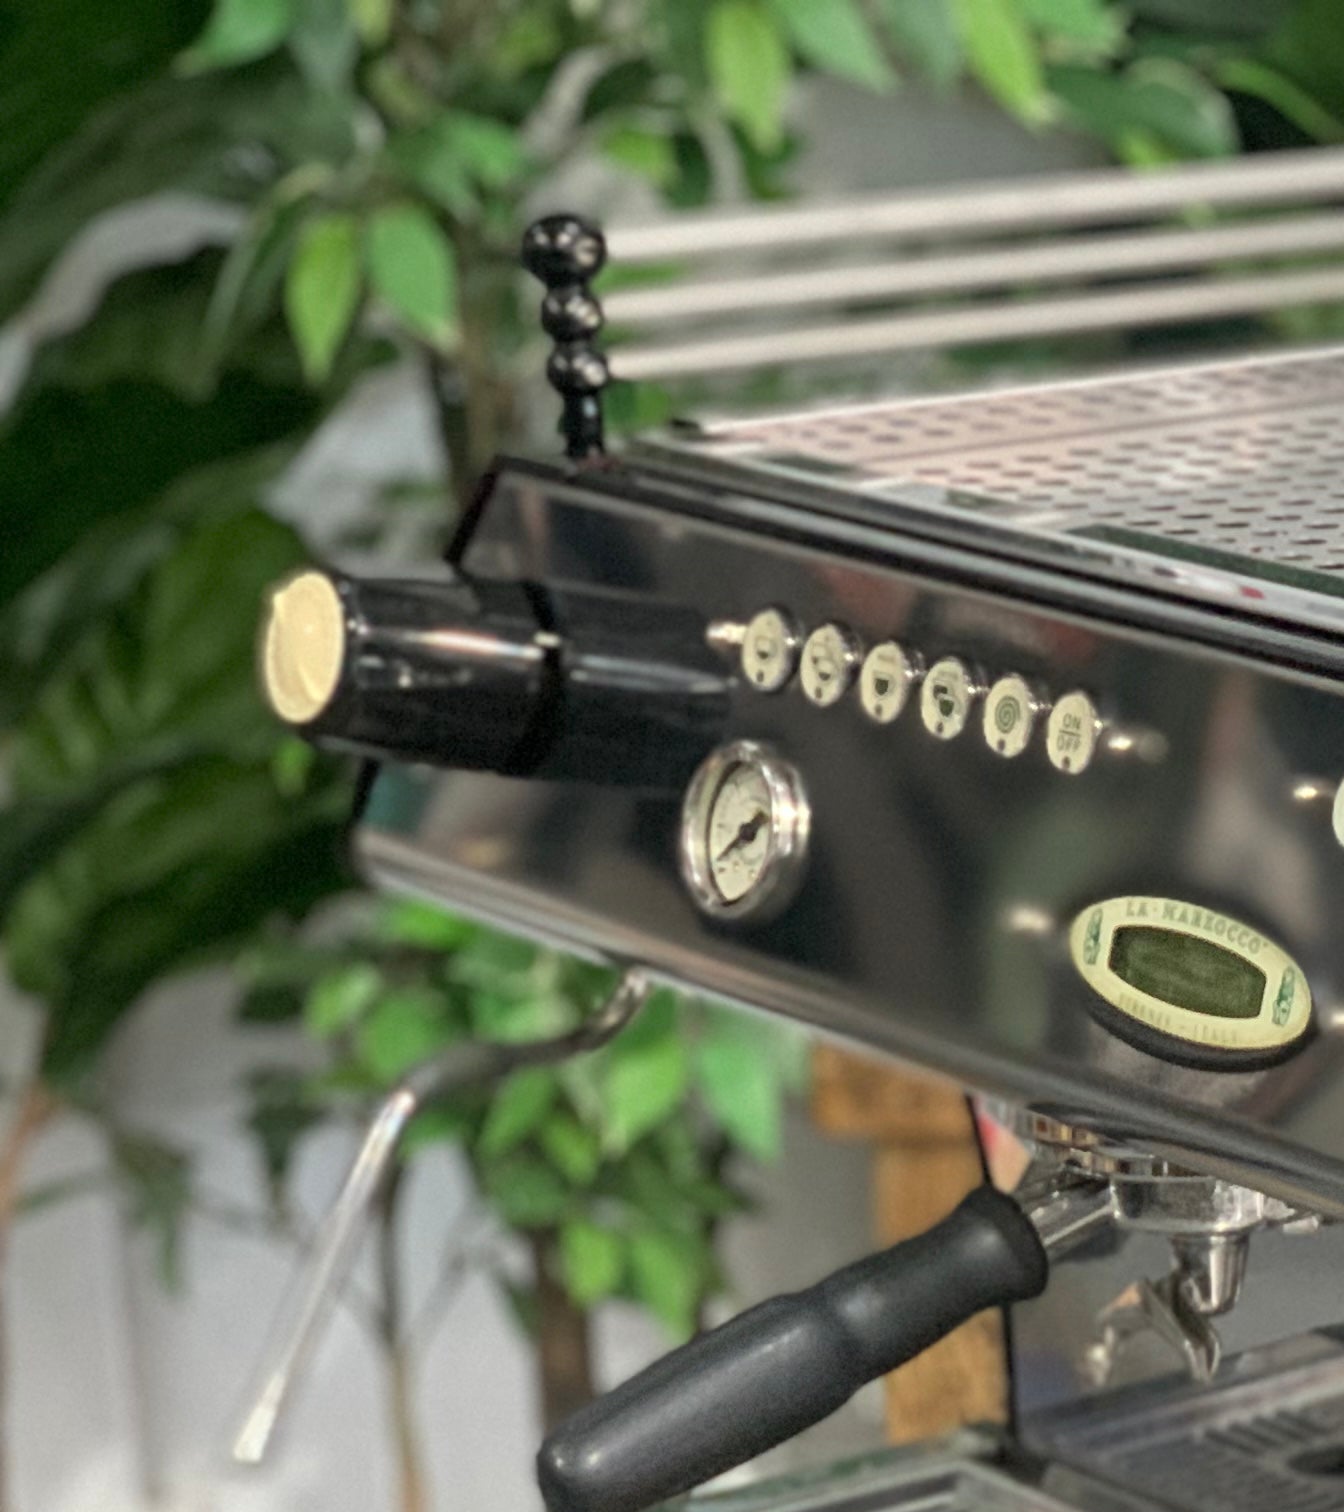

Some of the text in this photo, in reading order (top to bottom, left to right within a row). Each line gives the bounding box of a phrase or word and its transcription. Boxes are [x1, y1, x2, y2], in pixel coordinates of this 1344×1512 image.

[1063, 713, 1081, 730] ON
[1125, 901, 1261, 955] LA MARZOCCO
